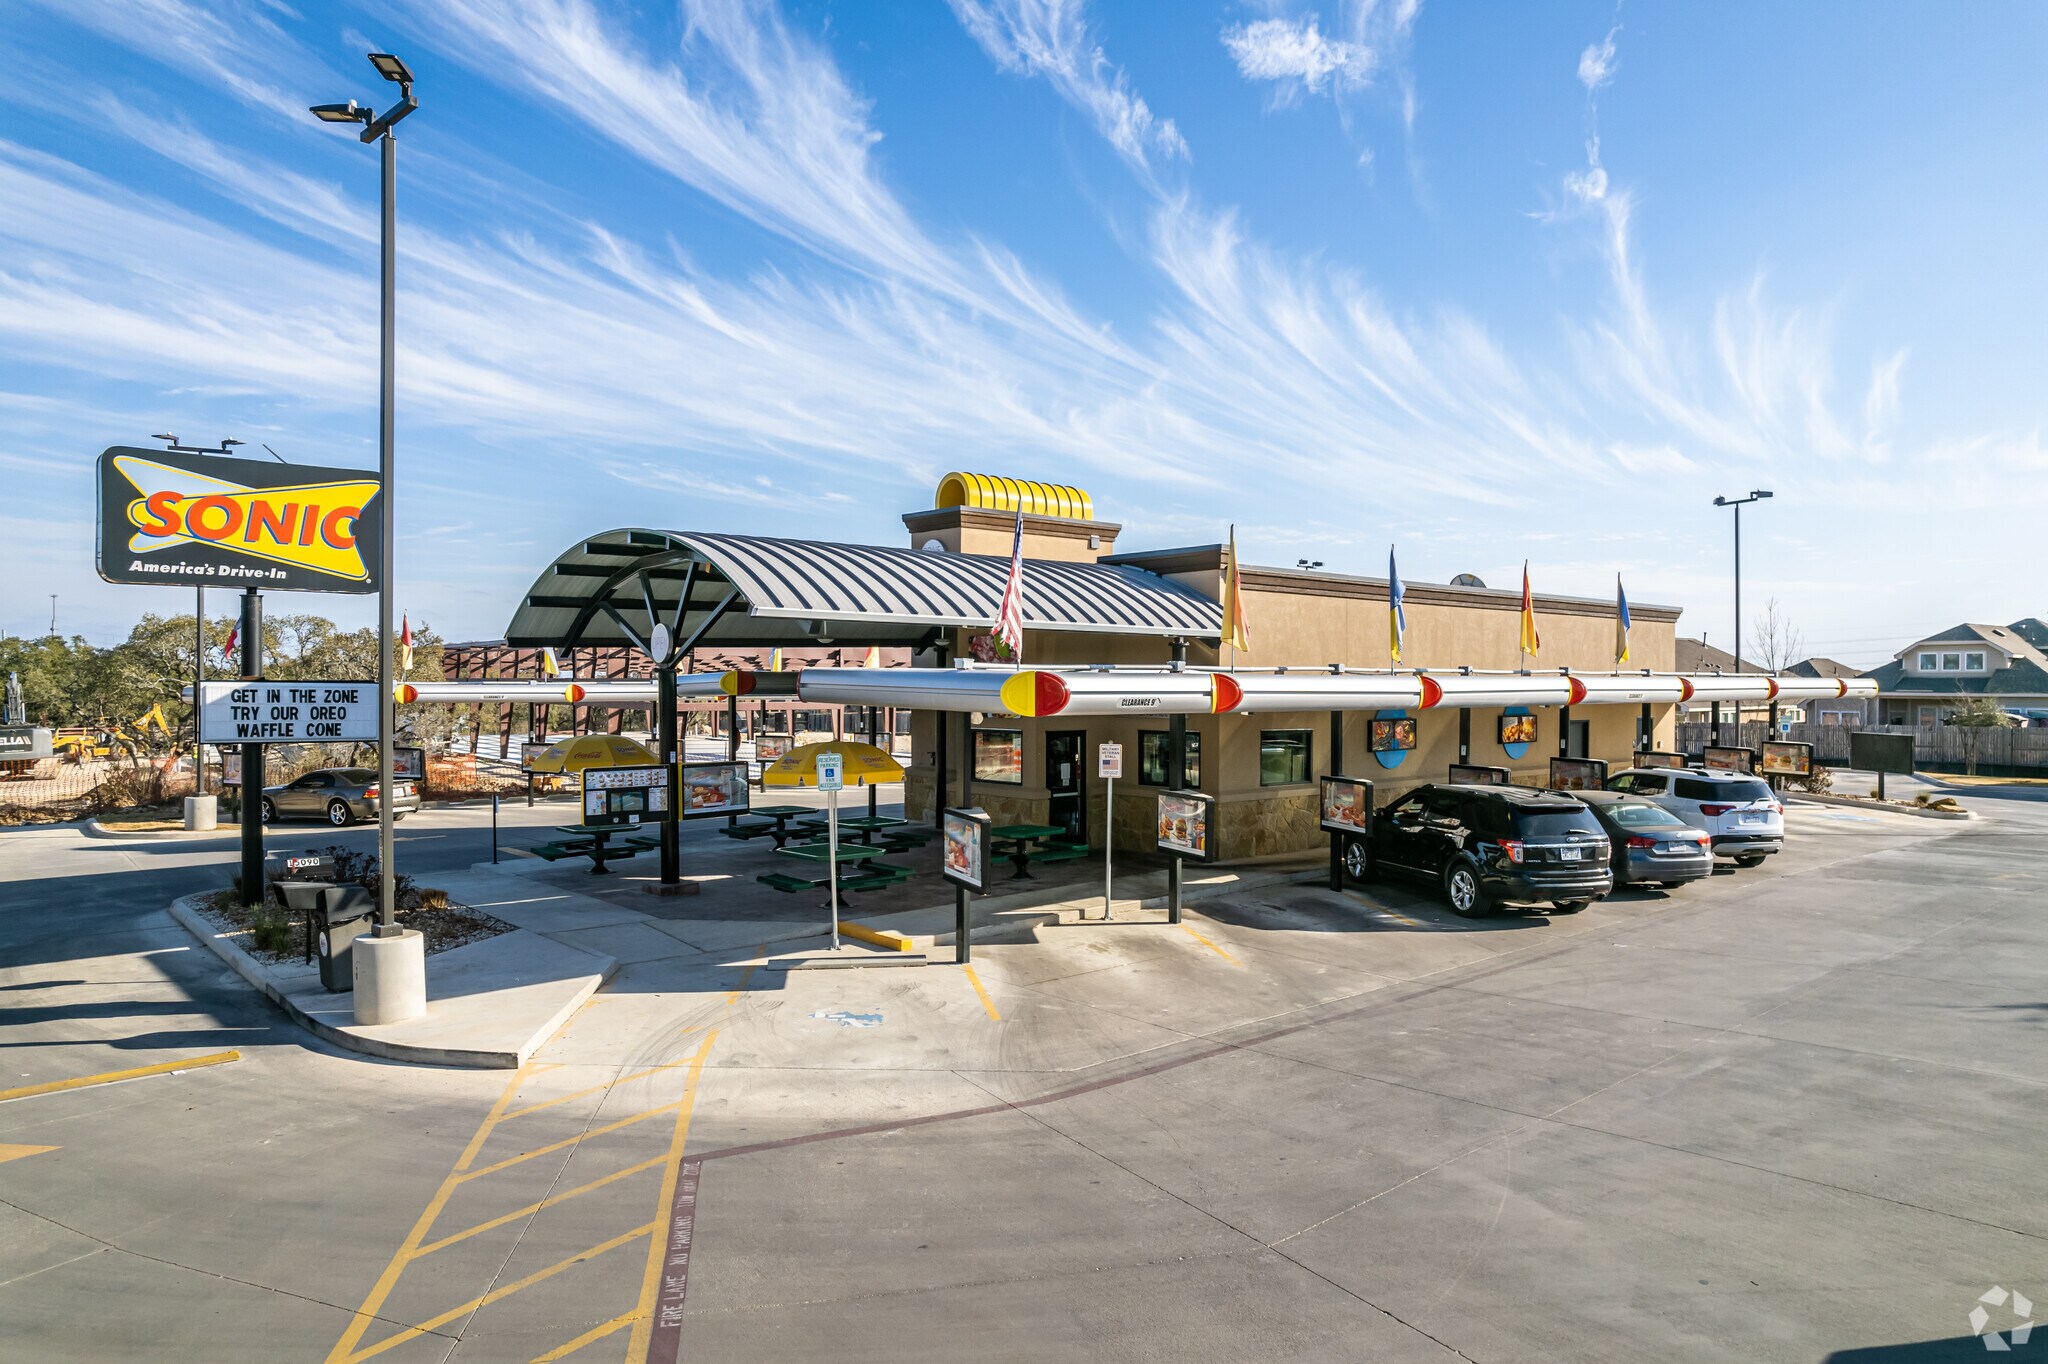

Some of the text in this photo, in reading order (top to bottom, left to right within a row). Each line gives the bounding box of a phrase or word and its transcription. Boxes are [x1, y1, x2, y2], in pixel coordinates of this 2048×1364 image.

[138, 490, 361, 550] SONIC
[129, 560, 215, 577] America's
[231, 689, 359, 704] GET IN THE ZONE
[1121, 698, 1150, 706] CLEARANCE
[231, 706, 347, 720] TRY OUR OREO
[236, 722, 342, 737] WAFFLE CONE
[671, 1215, 692, 1250] PARKING
[669, 1253, 689, 1266] NO
[664, 1274, 686, 1301] LANE
[660, 1302, 683, 1328] FIRE
